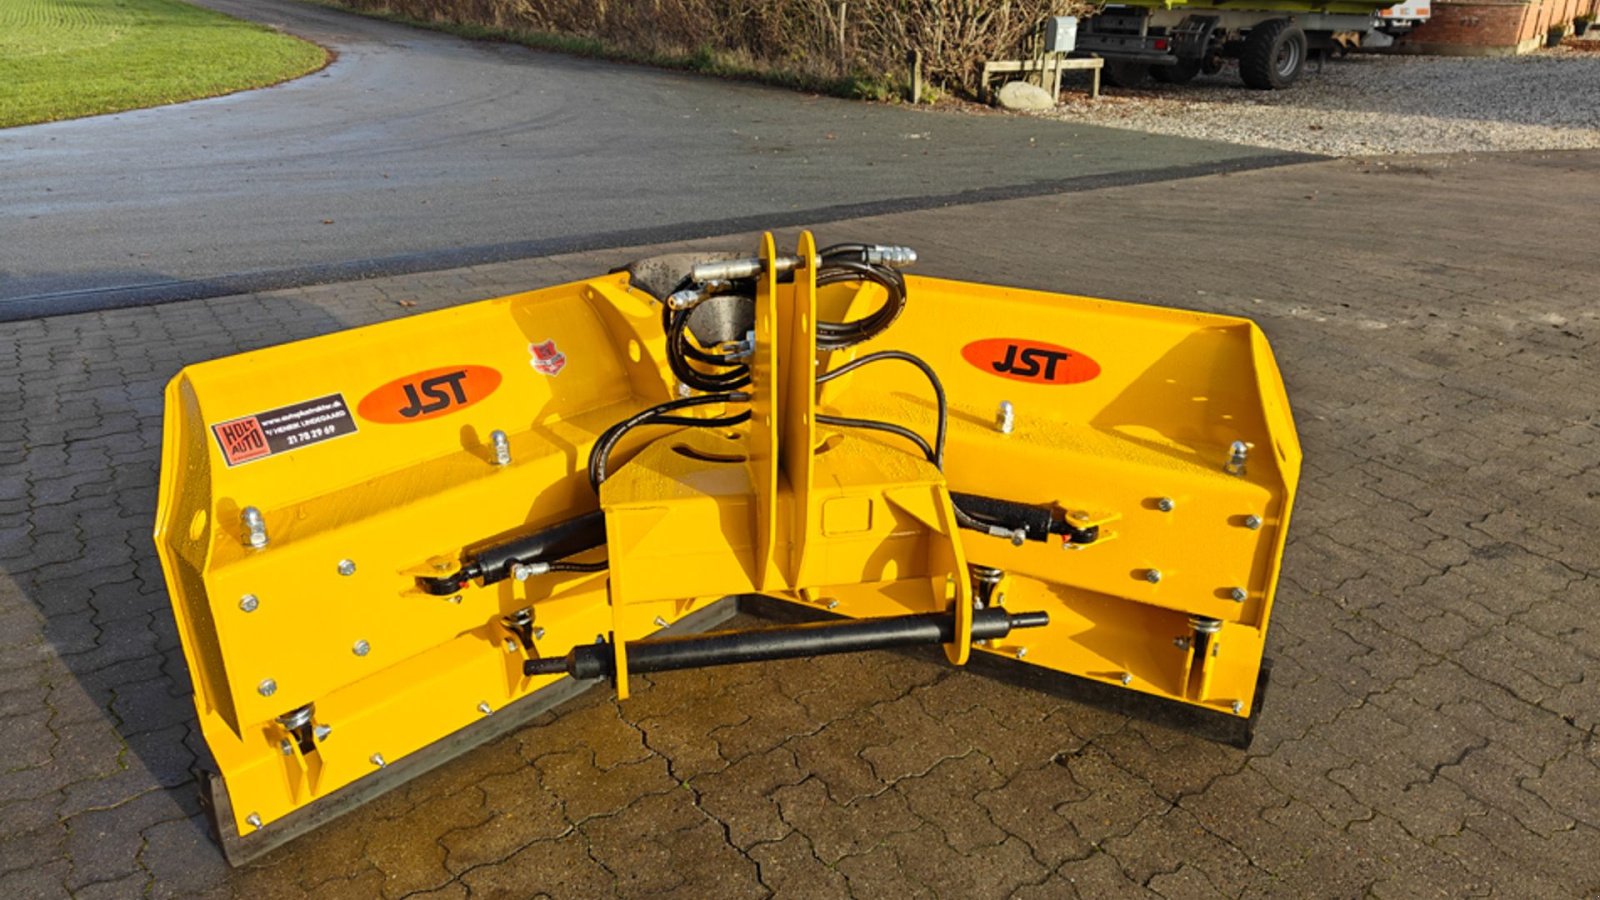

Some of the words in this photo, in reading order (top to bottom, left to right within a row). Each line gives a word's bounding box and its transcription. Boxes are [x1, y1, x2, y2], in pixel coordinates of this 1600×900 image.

[992, 344, 1067, 380] JST
[399, 371, 467, 417] JST
[301, 410, 346, 428] LINDEGAARD
[222, 420, 254, 445] HOLT
[232, 429, 264, 455] AUTO
[286, 434, 299, 445] 21
[310, 427, 323, 438] 29
